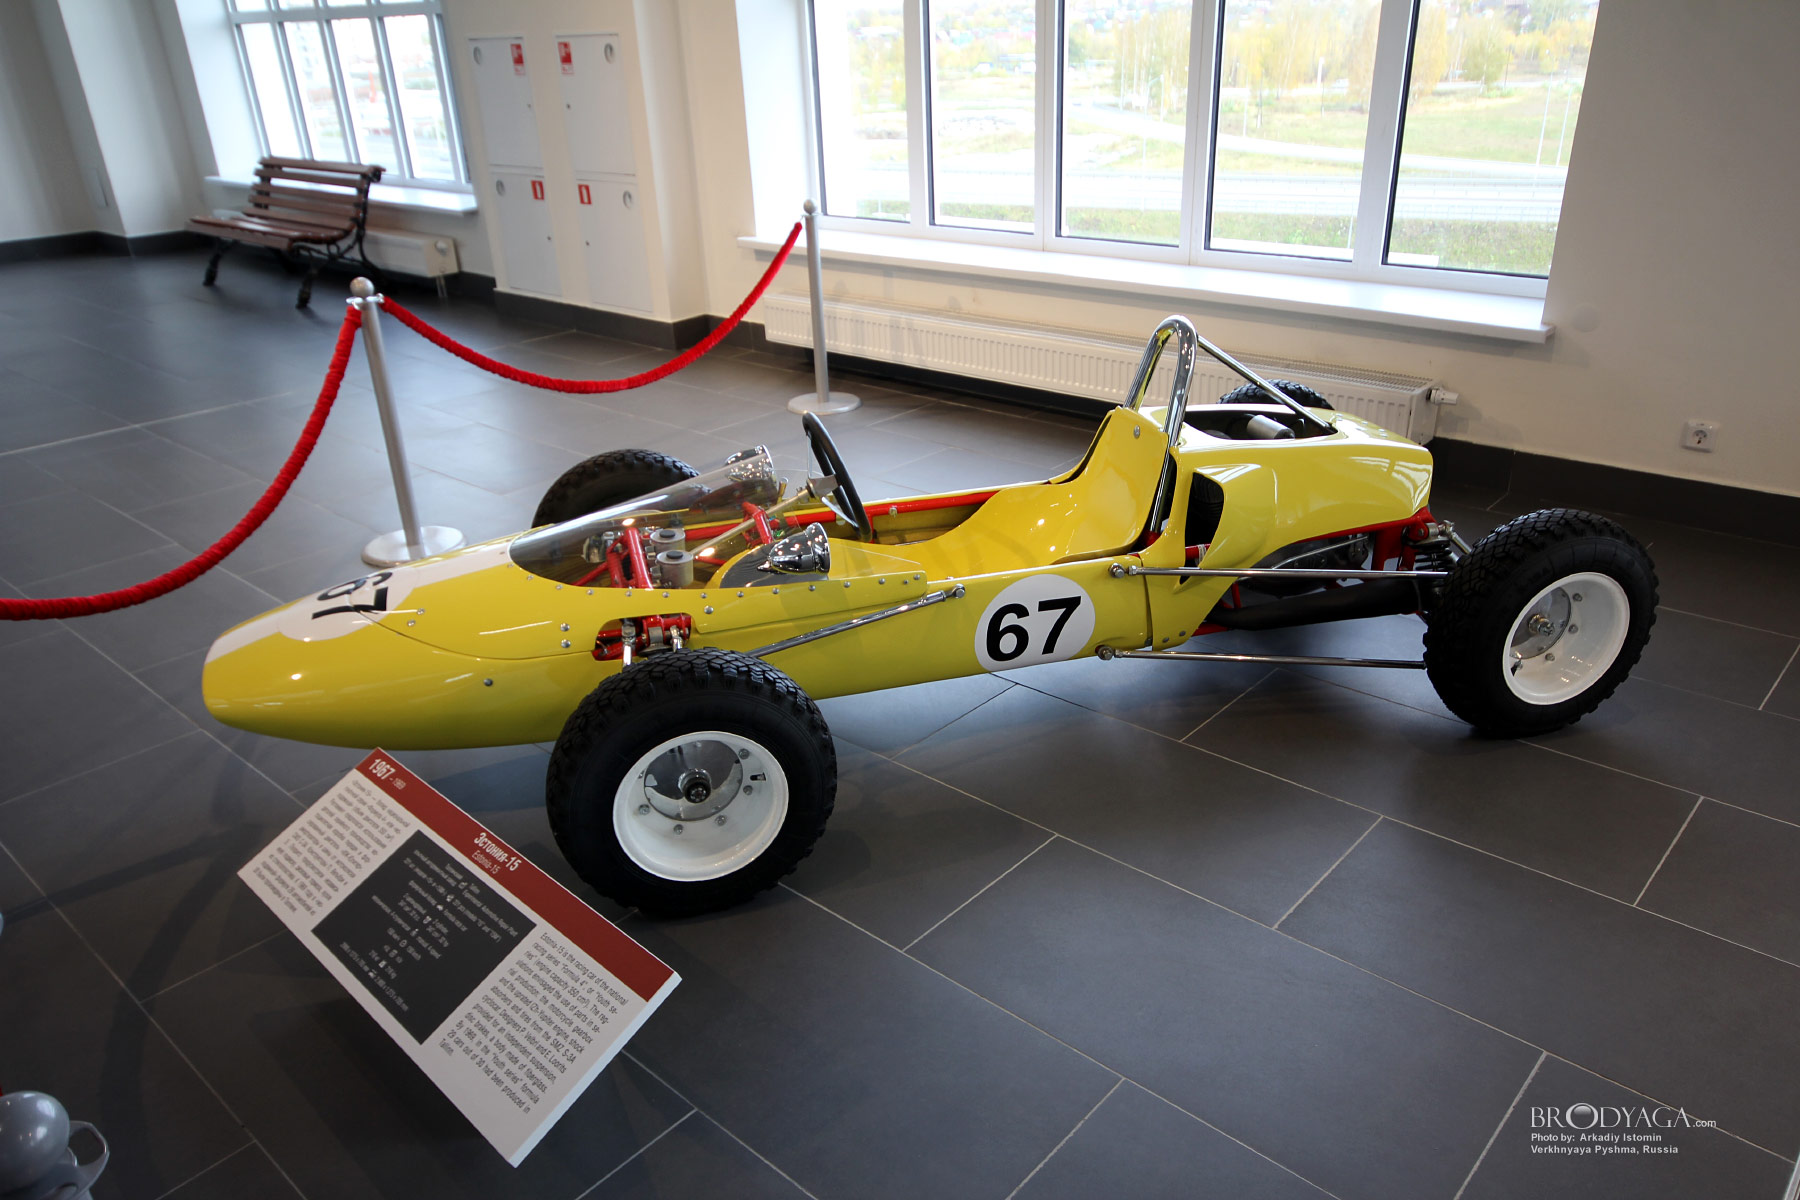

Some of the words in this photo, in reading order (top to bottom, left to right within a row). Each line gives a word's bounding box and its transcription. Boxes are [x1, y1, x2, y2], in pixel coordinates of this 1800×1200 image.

[986, 596, 1082, 662] 67
[368, 758, 396, 780] 1967
[471, 850, 501, 875] Estonia-15
[474, 832, 522, 872] Эстония-15
[539, 931, 566, 955] Estonia-15
[561, 950, 569, 958] is
[565, 953, 576, 964] the
[573, 959, 590, 976] racing
[531, 972, 556, 994] envisaged
[532, 941, 548, 957] racing
[544, 952, 561, 967] series
[585, 986, 595, 994] or
[607, 1005, 618, 1015] se-
[586, 970, 597, 981] car
[593, 977, 604, 985] of
[598, 980, 610, 992] the
[548, 971, 570, 991] capacity
[566, 985, 580, 998] 350
[589, 1003, 601, 1017] The
[597, 1012, 609, 1025] reg-
[552, 989, 563, 1001] the
[559, 997, 571, 1008] use
[606, 987, 629, 1006] national
[498, 976, 511, 987] and
[506, 982, 516, 993] the
[551, 1023, 570, 1043] engine,
[567, 1037, 585, 1054] shock
[538, 994, 549, 1006] the
[547, 1002, 574, 1028] motorcycle
[570, 1024, 594, 1045] gearbox
[568, 1004, 578, 1012] of
[572, 1009, 589, 1023] parts
[490, 1018, 501, 1028] for
[496, 1025, 506, 1034] an
[503, 1031, 533, 1059] independent
[498, 1008, 522, 1032] Designers
[534, 1043, 548, 1056] and
[509, 1003, 523, 1015] and
[519, 1010, 532, 1024] tires
[530, 1019, 544, 1034] from
[541, 1030, 552, 1042] the
[549, 1037, 565, 1053] SMZ
[590, 1023, 601, 1033] se-
[492, 1038, 507, 1054] body
[504, 1050, 520, 1066] made
[517, 1062, 528, 1071] of
[452, 1036, 465, 1049] cars
[461, 1045, 474, 1056] out
[469, 1052, 480, 1061] of
[482, 1063, 494, 1077] had
[490, 1072, 505, 1088] been
[500, 1084, 526, 1109] produced
[480, 1044, 491, 1056] the
[520, 1082, 540, 1105] formula
